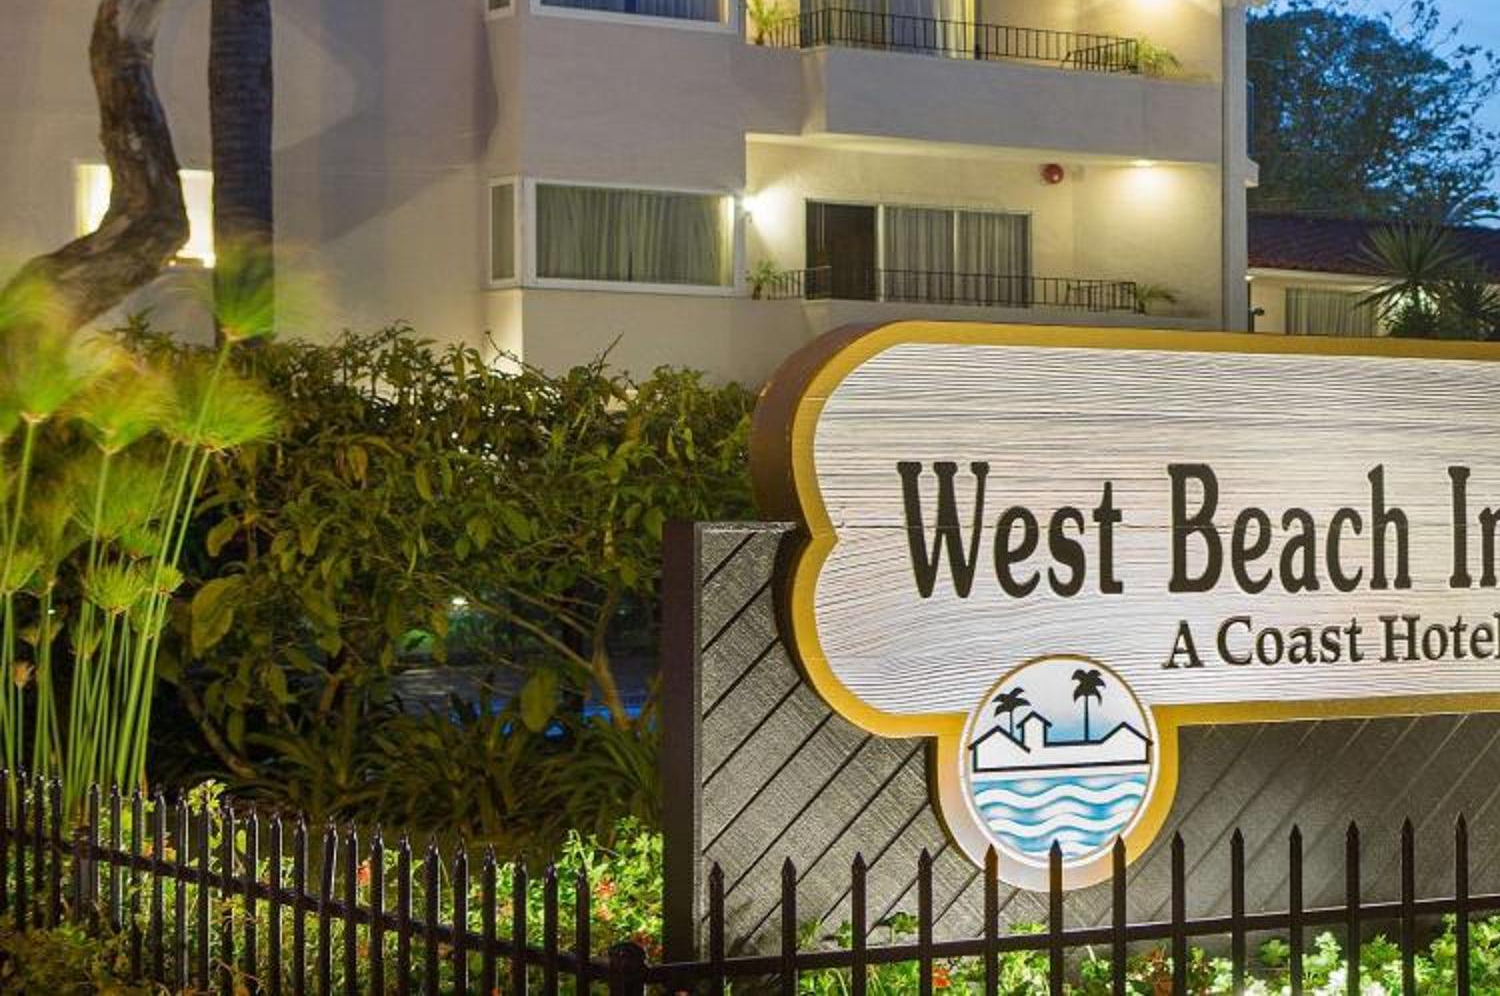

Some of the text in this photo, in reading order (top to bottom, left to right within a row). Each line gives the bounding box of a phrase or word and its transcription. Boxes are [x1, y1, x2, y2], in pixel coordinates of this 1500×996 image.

[897, 461, 1123, 599] West
[1167, 463, 1412, 594] Beach
[1162, 620, 1204, 670] A
[1217, 615, 1364, 667] Coast
